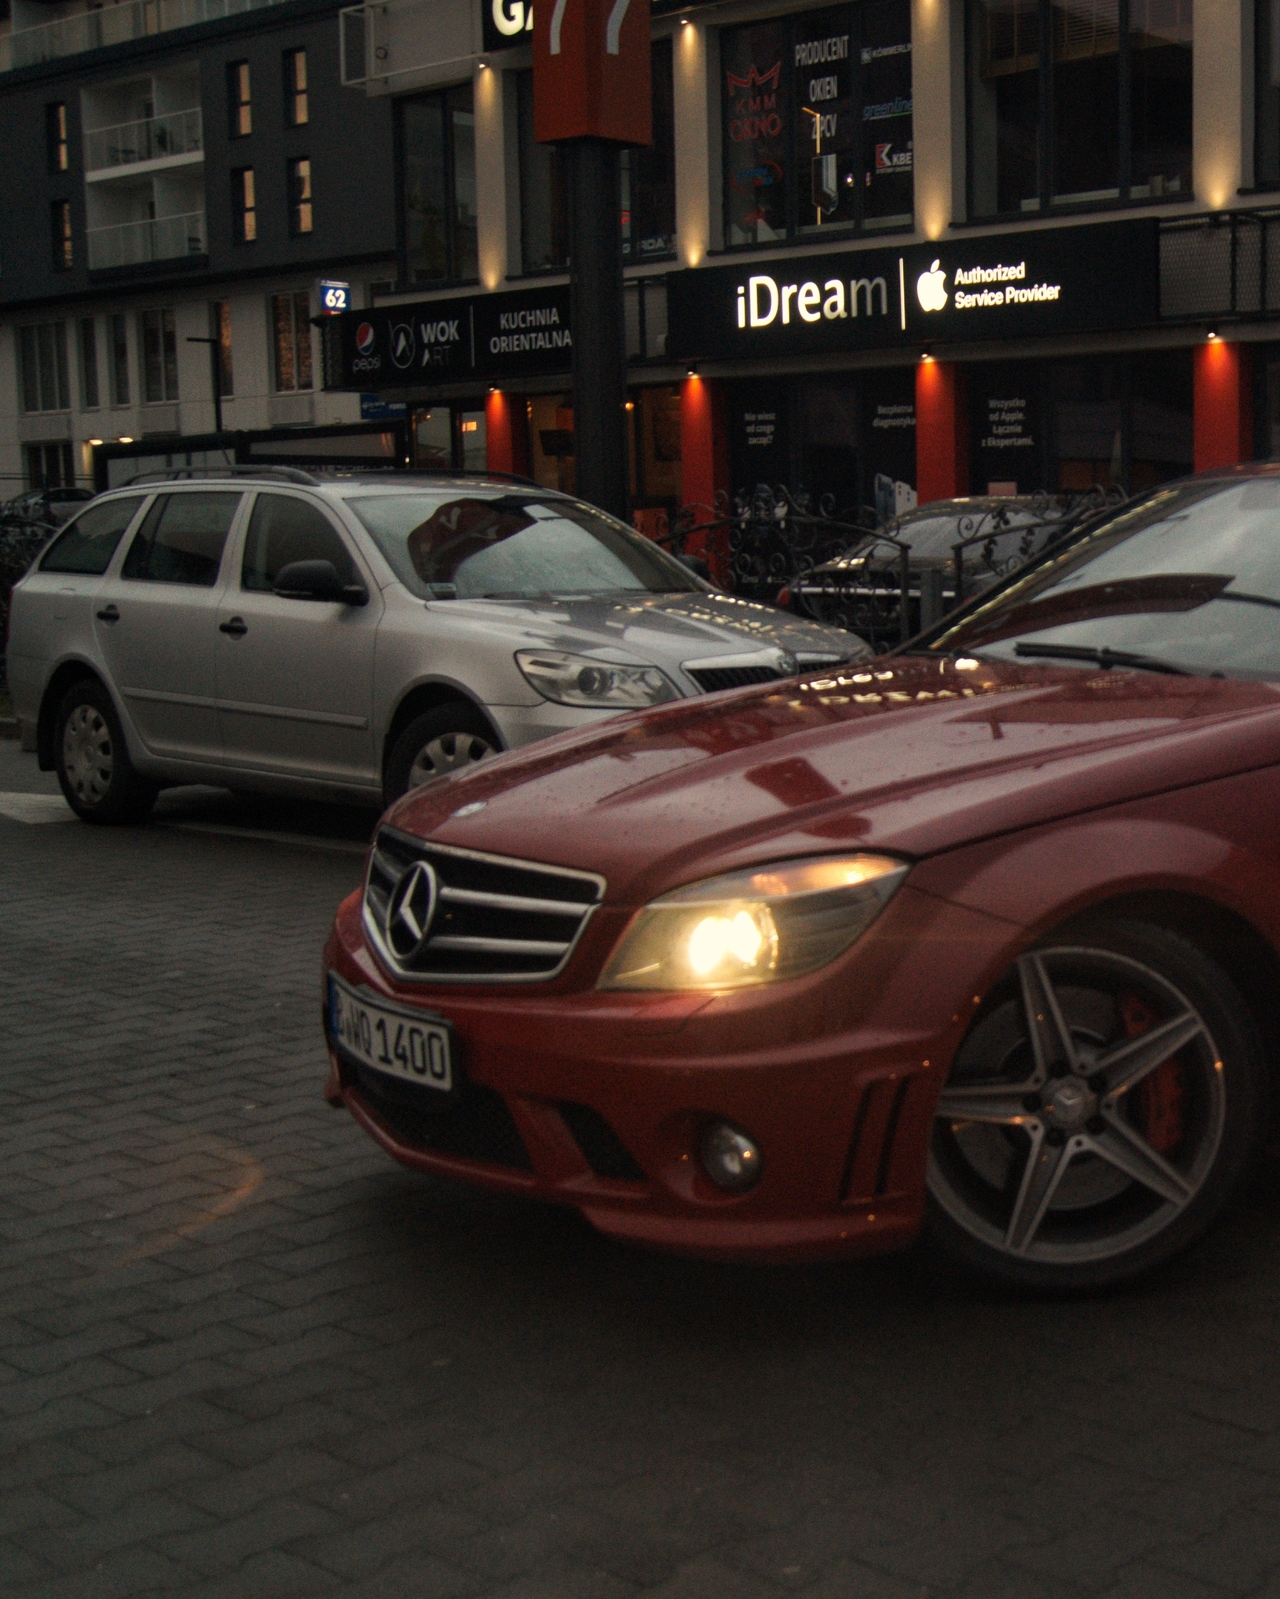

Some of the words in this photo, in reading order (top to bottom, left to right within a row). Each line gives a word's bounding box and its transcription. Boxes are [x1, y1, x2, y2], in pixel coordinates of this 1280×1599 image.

[795, 35, 849, 67] PRODUCENT
[809, 75, 838, 103] OKIEN
[736, 93, 776, 114] KMM
[728, 113, 782, 141] OKNO
[892, 152, 913, 166] KBE
[953, 260, 1026, 286] Authorized
[324, 288, 347, 308] 62
[737, 274, 888, 329] iDream
[954, 288, 1004, 310] Service
[1005, 281, 1061, 305] Provider
[500, 307, 560, 330] KUCHNIA
[421, 319, 460, 344] WOK
[489, 329, 573, 354] ORIENTALNA
[352, 356, 382, 374] pepsi
[421, 345, 452, 367] ART
[376, 1017, 447, 1081] 1400
